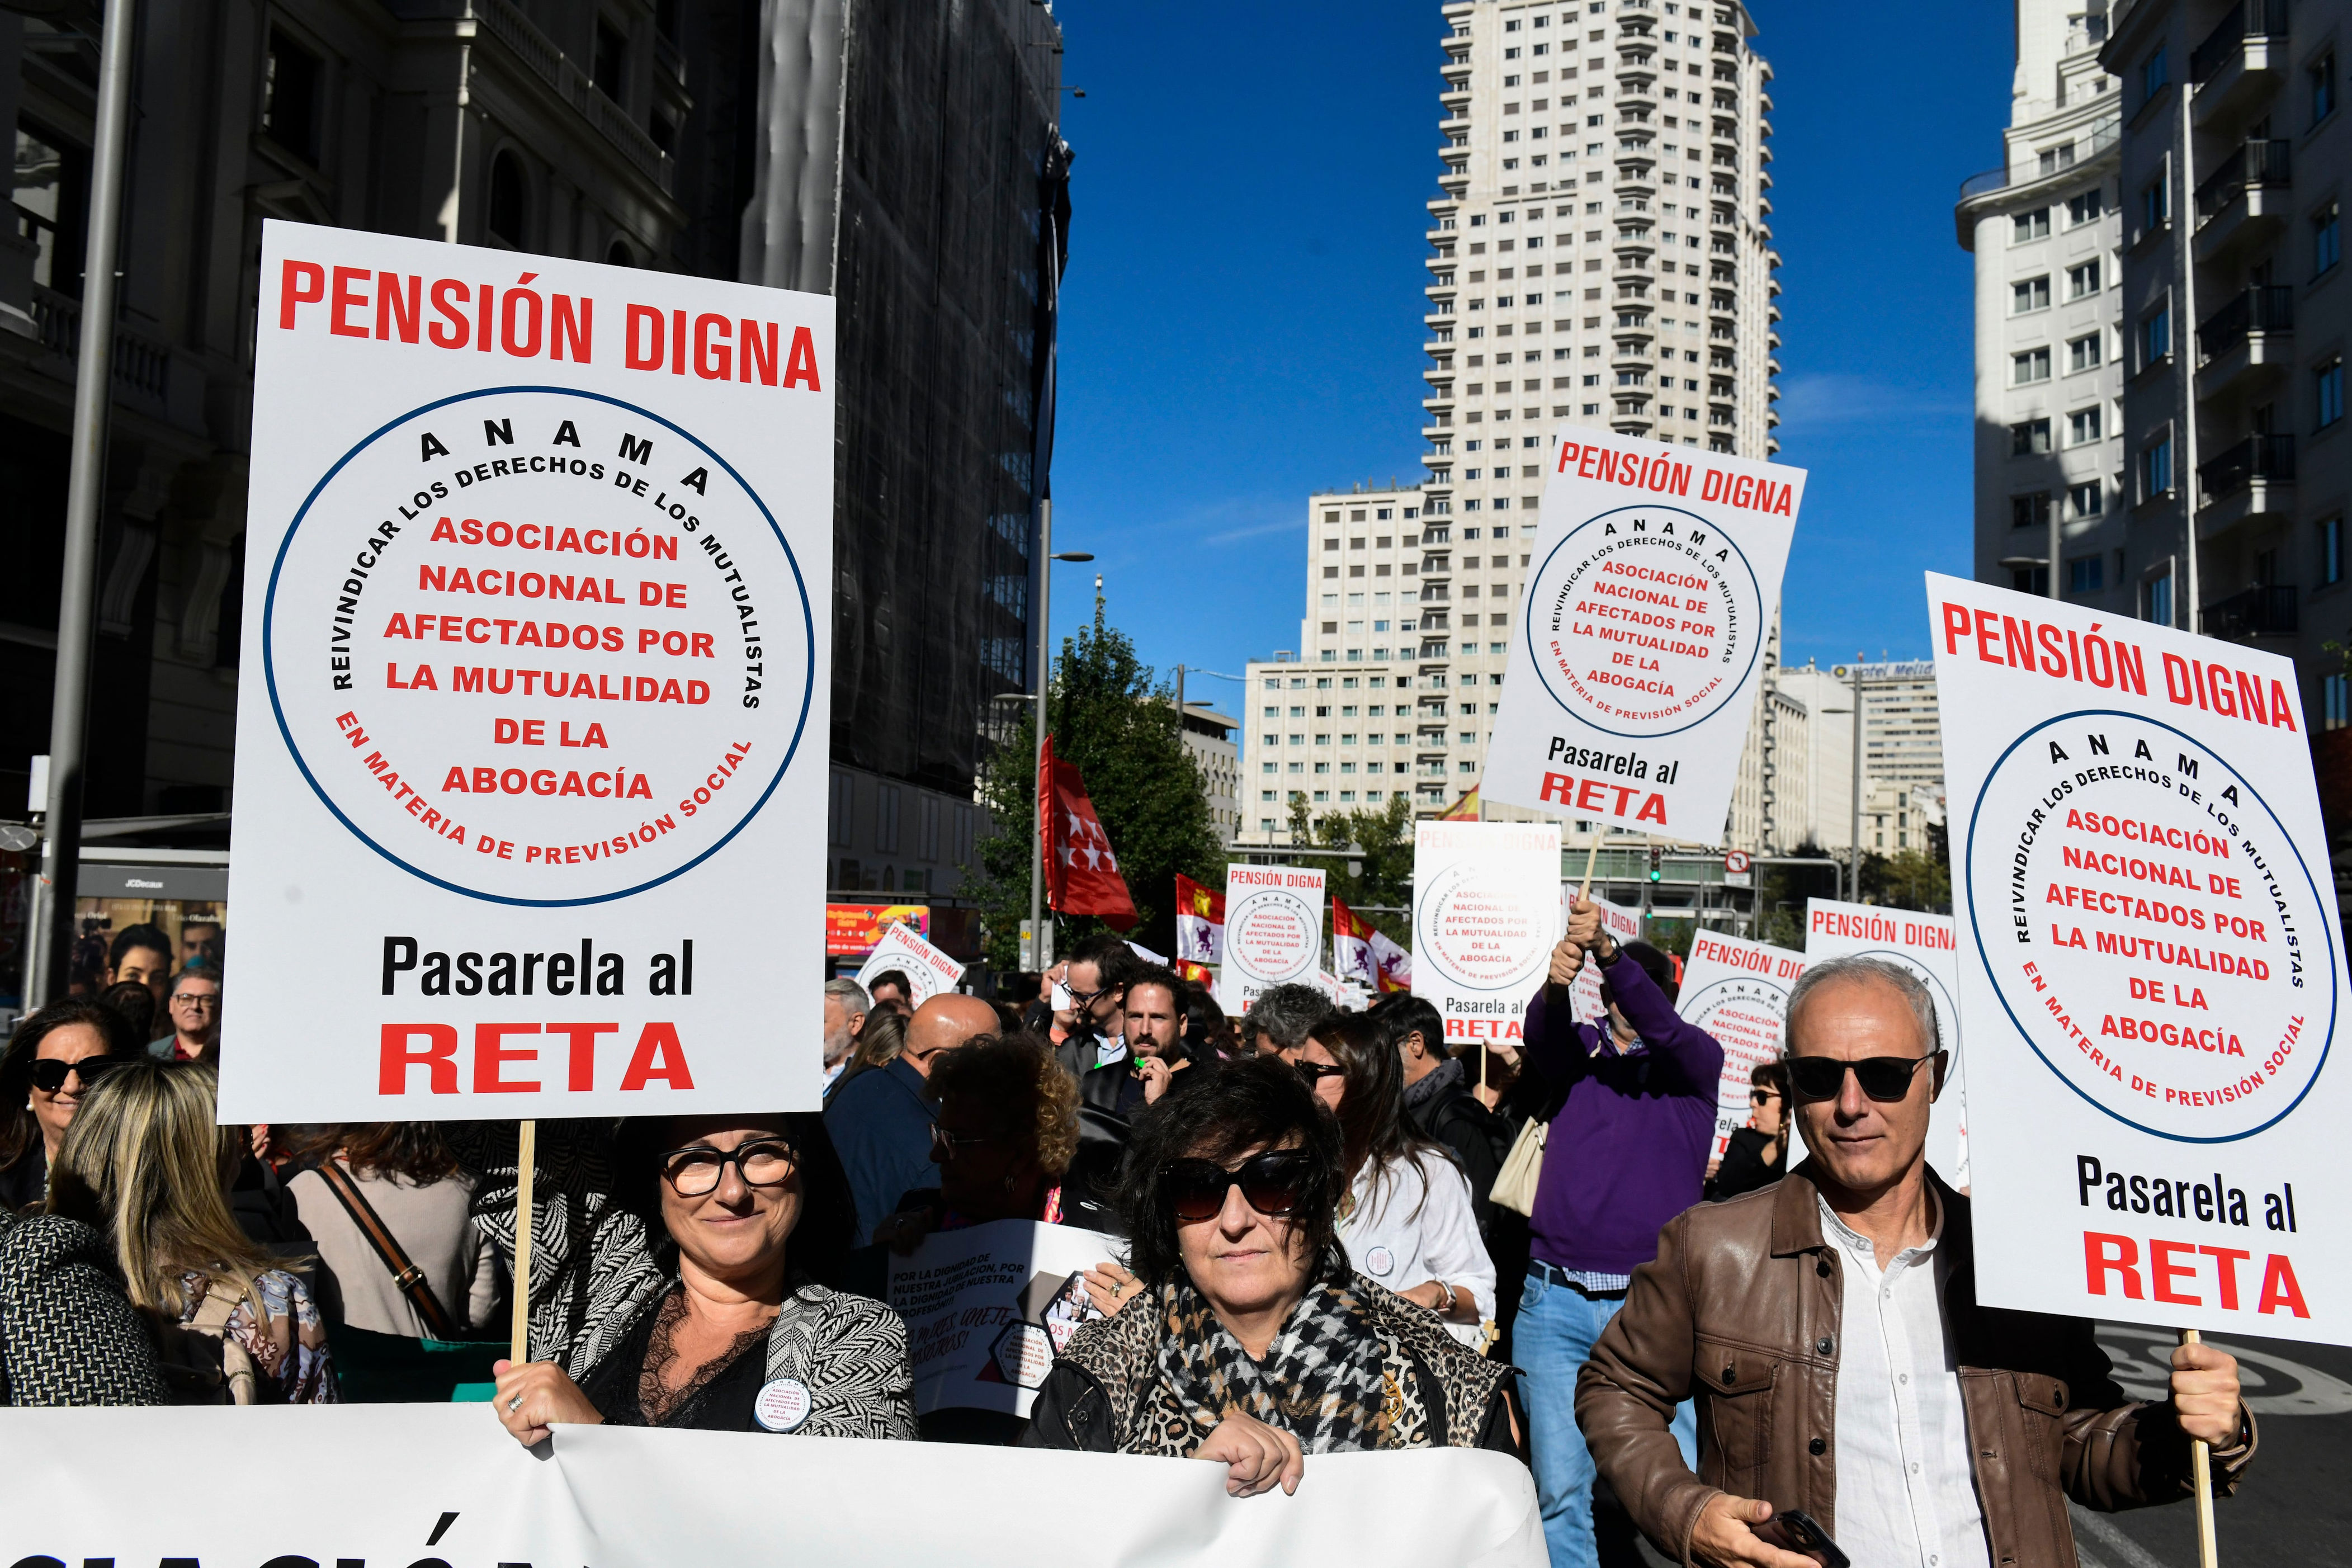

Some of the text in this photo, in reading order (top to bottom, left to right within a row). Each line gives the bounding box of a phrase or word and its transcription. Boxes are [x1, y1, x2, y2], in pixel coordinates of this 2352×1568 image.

[280, 259, 822, 393] PENSIÓN DIGNA
[1557, 441, 1792, 517] PENSIÓN DIGNA
[431, 517, 678, 561] ASOCIACIÓN
[332, 457, 763, 710] REIVINDICAR LOS DERECHOS DE LOS MUTUALISTAS
[420, 565, 688, 610] NACIONAL DE
[1593, 581, 1708, 613] NACIONAL DE
[1602, 561, 1708, 592] ASOCIACIÓN
[1552, 537, 1736, 663] REIVINDICAR LOS DERECHOS DE LOS MUTUALISTAS
[1576, 601, 1716, 637] AFECTADOS POR
[384, 613, 715, 659] AFECTADOS POR
[1572, 622, 1709, 658] LA MUTUALIDAD
[1551, 640, 1722, 720] EN MATERIA DE PREVISIÓN SOCIAL
[1612, 651, 1660, 672] DE LA
[1942, 602, 2297, 733] PENSIÓN DIGNA
[387, 663, 711, 706] LA MUTUALIDAD
[1587, 669, 1675, 697] ABOGACÍA
[495, 719, 610, 749] DE LA
[1548, 736, 1679, 785] Pasarela al
[337, 711, 753, 865] EN MATERIA DE PREVISIÓN SOCIAL
[443, 767, 654, 800] ABOGACÍA
[1539, 771, 1668, 825] RETA
[2066, 808, 2230, 859] ASOCIACIÓN
[125, 879, 163, 888] JCDecaux
[1231, 870, 1322, 889] PENSIÓN DIGNA
[2012, 766, 2303, 987] REIVINDICAR LOS DERECHOS DE LOS MUTUALISTAS
[2063, 846, 2242, 899] NACIONAL DE
[1445, 916, 1504, 924] AFECTADOS
[1453, 904, 1504, 912] NACIONAL
[1612, 912, 1636, 937] DIGNA
[1812, 910, 1896, 943] PENSIÓN
[2046, 883, 2268, 943] AFECTADOS POR
[382, 937, 694, 997] Pasarela al
[890, 927, 959, 980] PENSIÓN DIGNA
[1435, 941, 1443, 951] EN
[1441, 951, 1466, 975] MATERIA
[1480, 966, 1518, 980] PREVISIÓN
[1460, 954, 1512, 962] ABOGACÍA
[1695, 939, 1805, 981] PENSIÓN DIG
[2051, 923, 2270, 981] LA MUTUALIDAD
[1446, 997, 1523, 1014] Pasarela al
[2129, 976, 2209, 1011] DE LA
[1446, 1018, 1523, 1038] RETA
[1713, 1019, 1778, 1041] NACIONAL DE
[1718, 1008, 1779, 1028] ASOCIACIÓN
[2023, 961, 2304, 1107] EN MATERIA DE PREVISIÓN SOCIAL
[2100, 1014, 2245, 1057] ABOGACÍA
[379, 1022, 696, 1095] RETA
[2077, 1154, 2297, 1233] Pasarela al
[894, 1253, 991, 1282] POR LA DIGNIDAD DE
[894, 1280, 941, 1294] NUESTRA
[1000, 1263, 1024, 1273] POR
[2083, 1230, 2311, 1319] RETA
[894, 1275, 1014, 1307] LA DIGNIDAD DE NUESTRA
